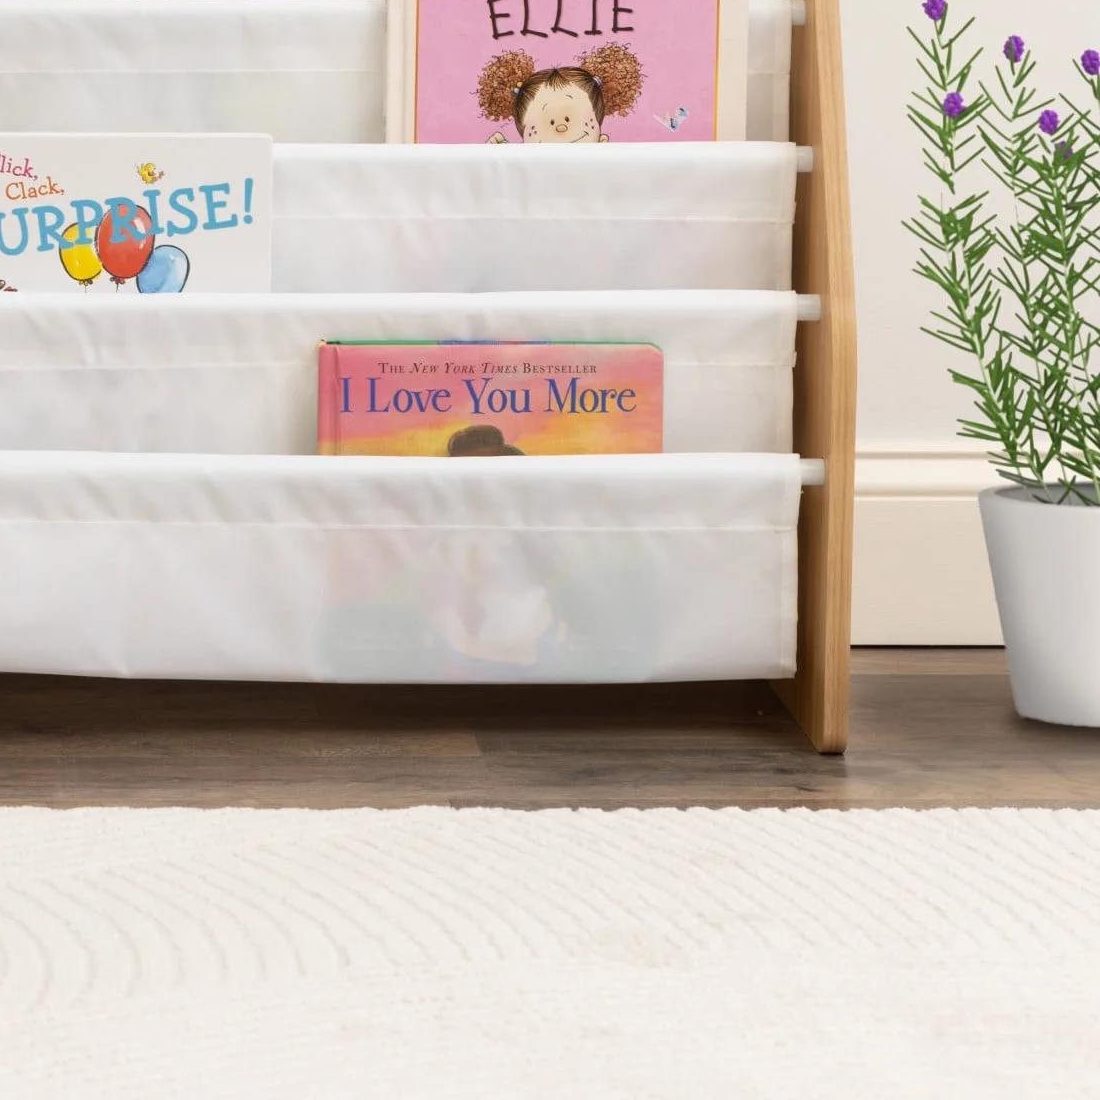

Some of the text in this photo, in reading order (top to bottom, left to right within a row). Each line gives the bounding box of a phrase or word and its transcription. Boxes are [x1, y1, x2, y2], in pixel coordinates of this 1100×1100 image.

[5, 176, 66, 201] Clack,
[339, 376, 637, 415] I Love You More
